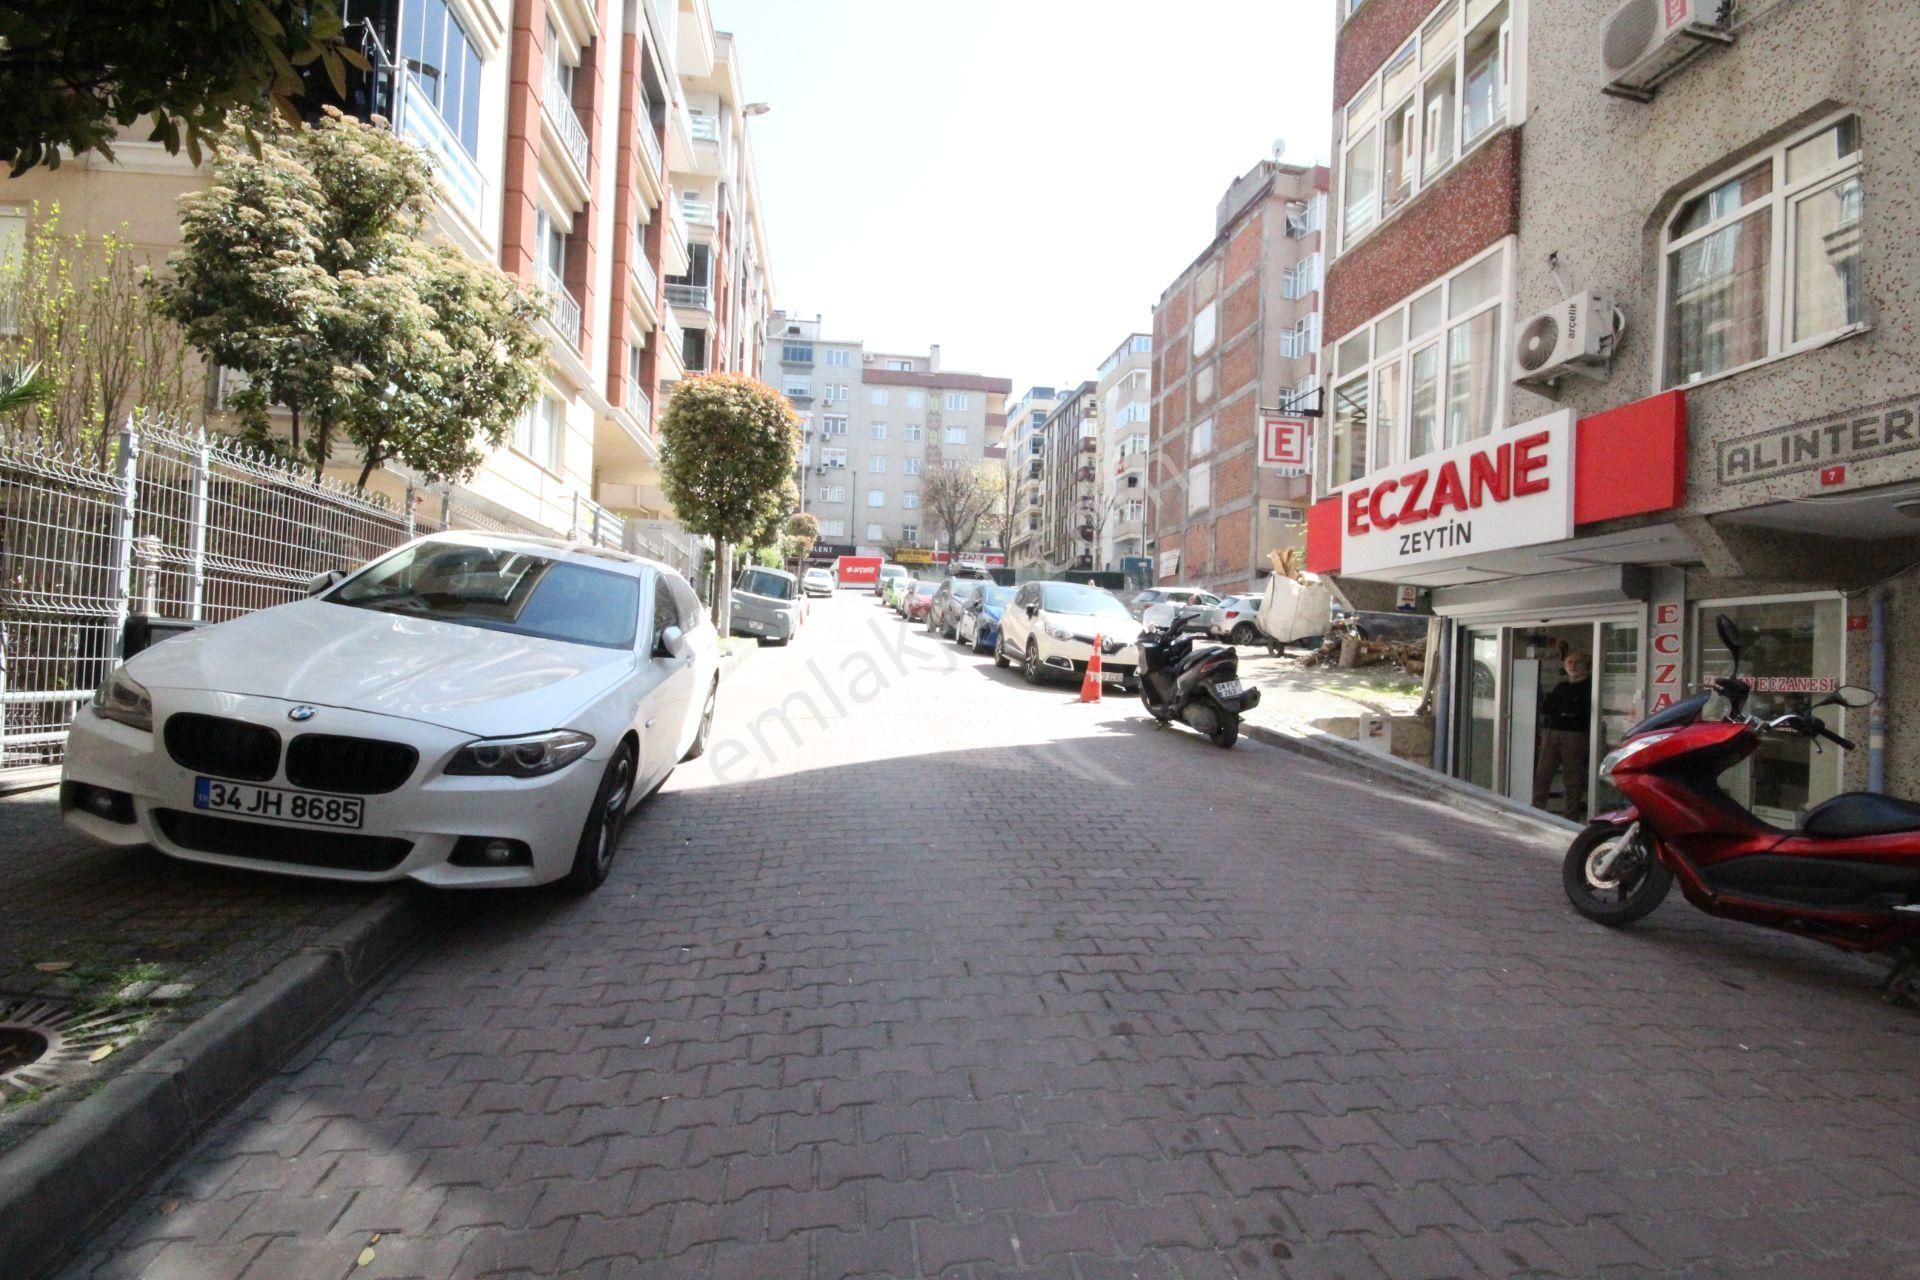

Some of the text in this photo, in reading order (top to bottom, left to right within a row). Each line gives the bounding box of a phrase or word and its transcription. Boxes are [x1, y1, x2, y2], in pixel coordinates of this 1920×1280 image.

[1274, 427, 1294, 457] E
[1727, 407, 1920, 477] ALINTER
[1347, 430, 1550, 537] ECZANE
[1828, 471, 1836, 481] 7
[1398, 518, 1473, 556] ZEYTİN
[1757, 675, 1836, 692] ECZANESİ
[210, 783, 360, 824] 34 JH 8685
